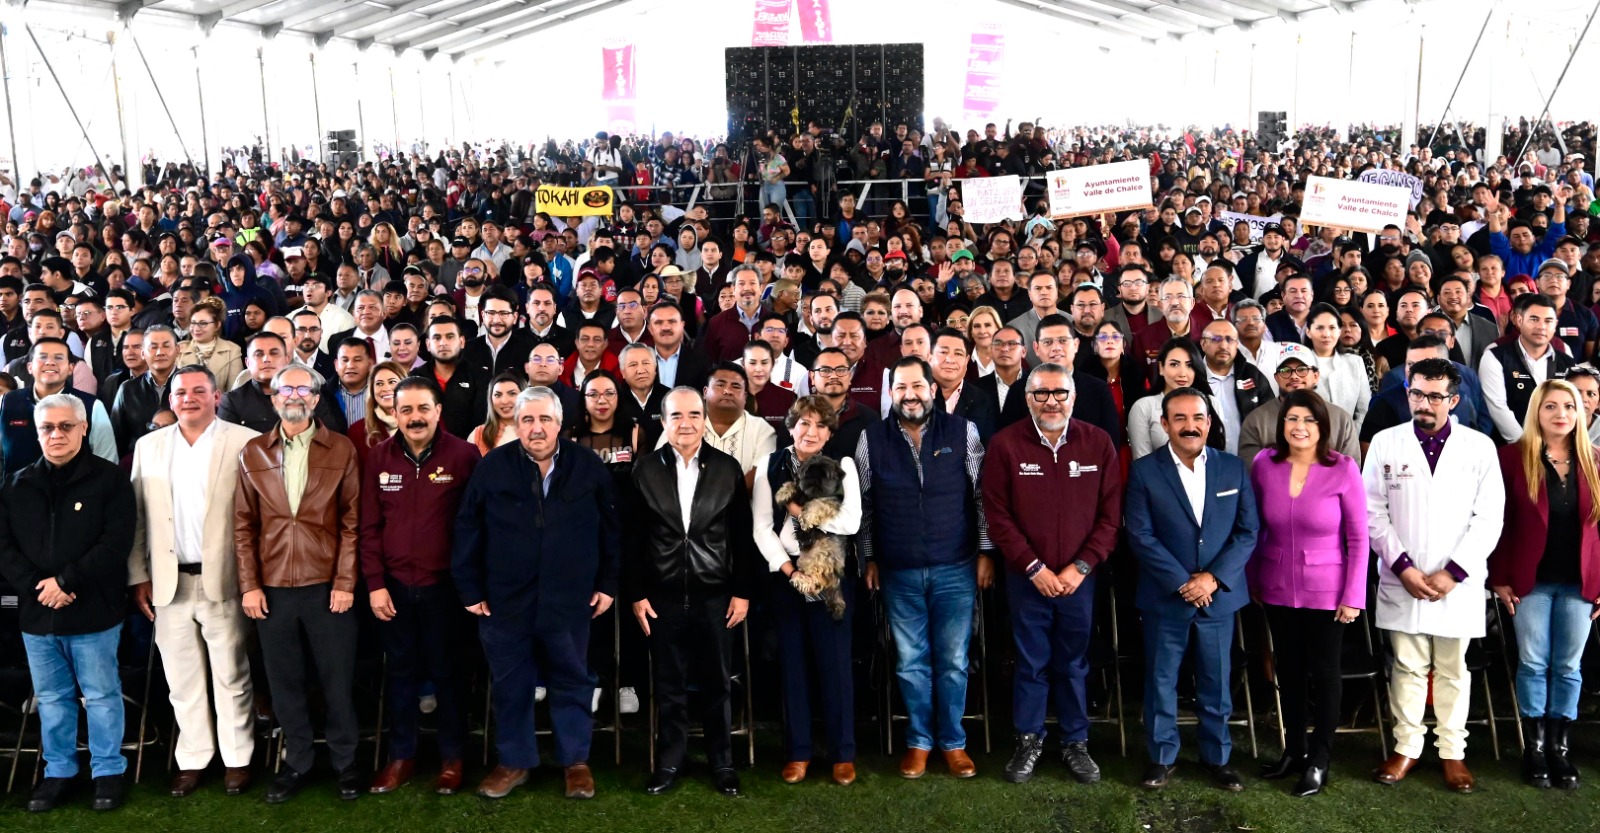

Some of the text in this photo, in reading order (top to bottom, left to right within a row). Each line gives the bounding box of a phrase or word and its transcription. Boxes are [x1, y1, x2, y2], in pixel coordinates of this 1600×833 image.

[1084, 176, 1140, 189] Ayuntamiento
[1083, 189, 1103, 197] Valle
[1116, 184, 1143, 193] Chalco
[1341, 195, 1398, 208] Ayuntamiento
[1337, 203, 1357, 212] Valle
[1371, 208, 1399, 217] Chalco
